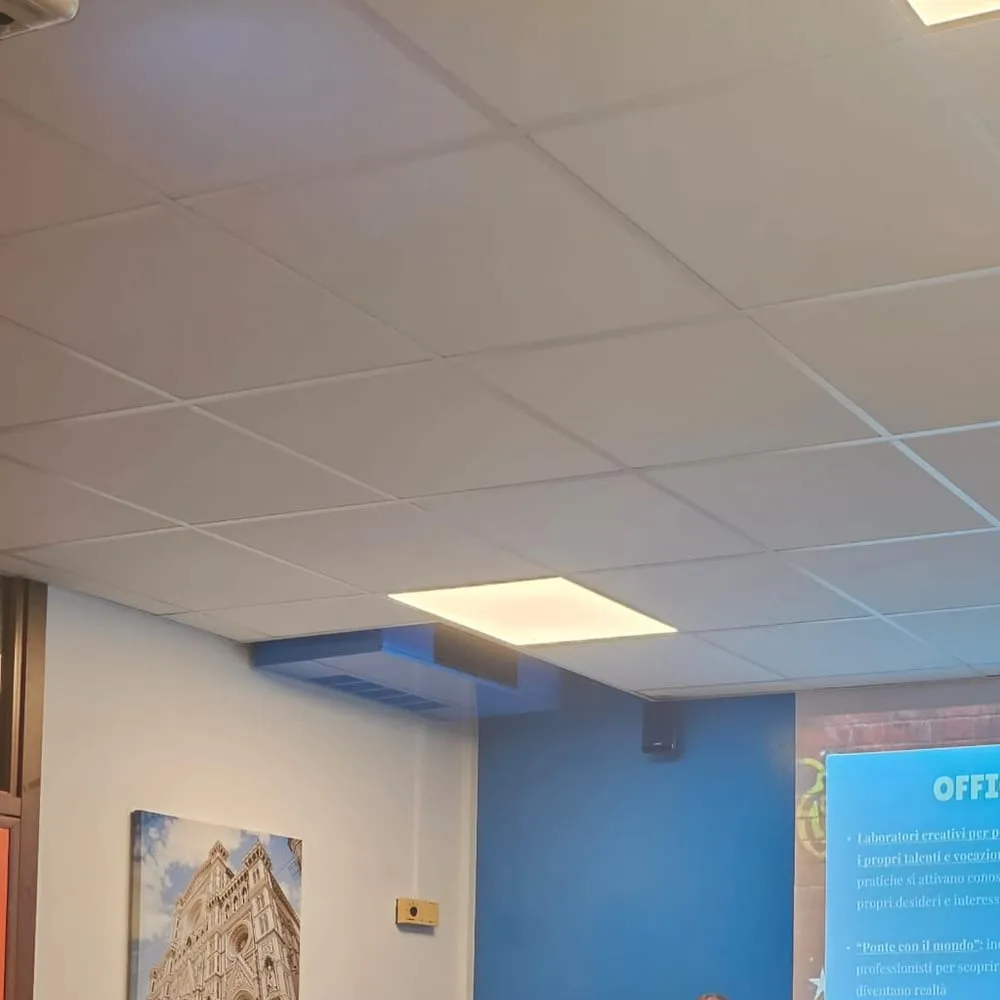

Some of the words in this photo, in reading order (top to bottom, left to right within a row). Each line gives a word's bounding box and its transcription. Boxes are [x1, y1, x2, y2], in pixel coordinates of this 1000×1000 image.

[857, 829, 919, 844] Laboratori
[921, 827, 966, 841] creativi
[968, 828, 990, 841] per
[863, 851, 902, 868] propri
[904, 850, 941, 865] talenti
[943, 854, 951, 864] e
[856, 873, 903, 890] pratiche
[906, 872, 916, 887] si
[918, 872, 964, 885] attivano
[856, 896, 892, 912] propri
[895, 895, 941, 908] desideri
[943, 896, 951, 906] e
[898, 942, 919, 953] con
[922, 940, 930, 953] il
[856, 962, 933, 977] professionisti
[935, 963, 957, 976] per
[856, 984, 912, 998] diventano
[914, 983, 947, 997] realtà
